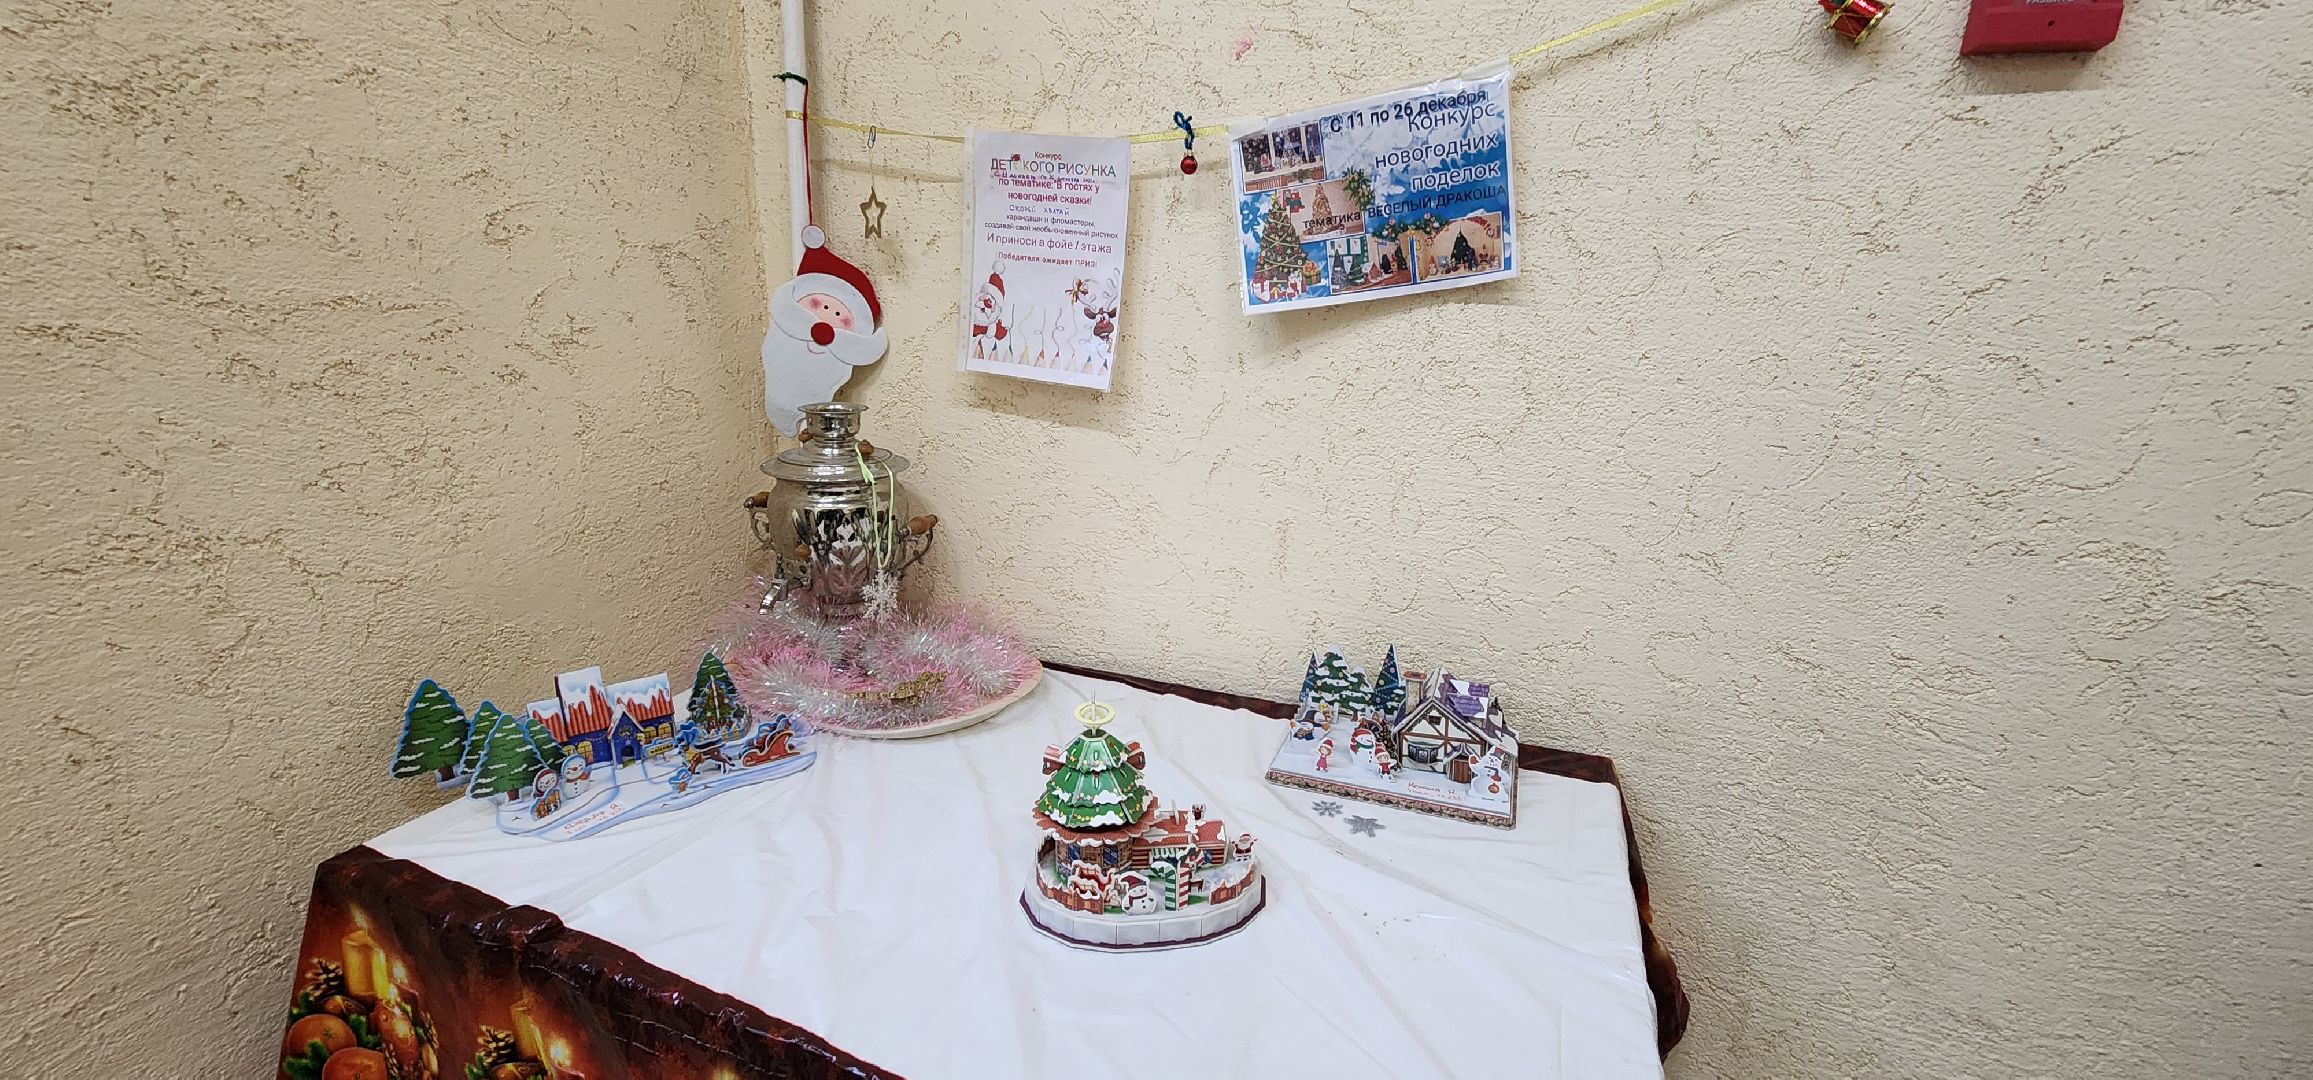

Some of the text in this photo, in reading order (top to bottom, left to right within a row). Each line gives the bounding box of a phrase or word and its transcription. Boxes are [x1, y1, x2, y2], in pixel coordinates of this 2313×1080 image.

[1330, 90, 1487, 133] С 11 по 26 декабря
[990, 158, 1117, 178] ДЕТКОГО РИСУНКА
[1411, 162, 1500, 191] поделок
[998, 178, 1009, 187] по
[1064, 182, 1093, 192] гостях
[1008, 191, 1058, 203] новогодней
[1302, 185, 1506, 229] тематика ВЕСЕЛЫЙ ДРАКОША
[987, 232, 995, 243] И
[995, 234, 1037, 246] приноси
[1046, 238, 1073, 251] фойе
[1080, 242, 1112, 254] этажа
